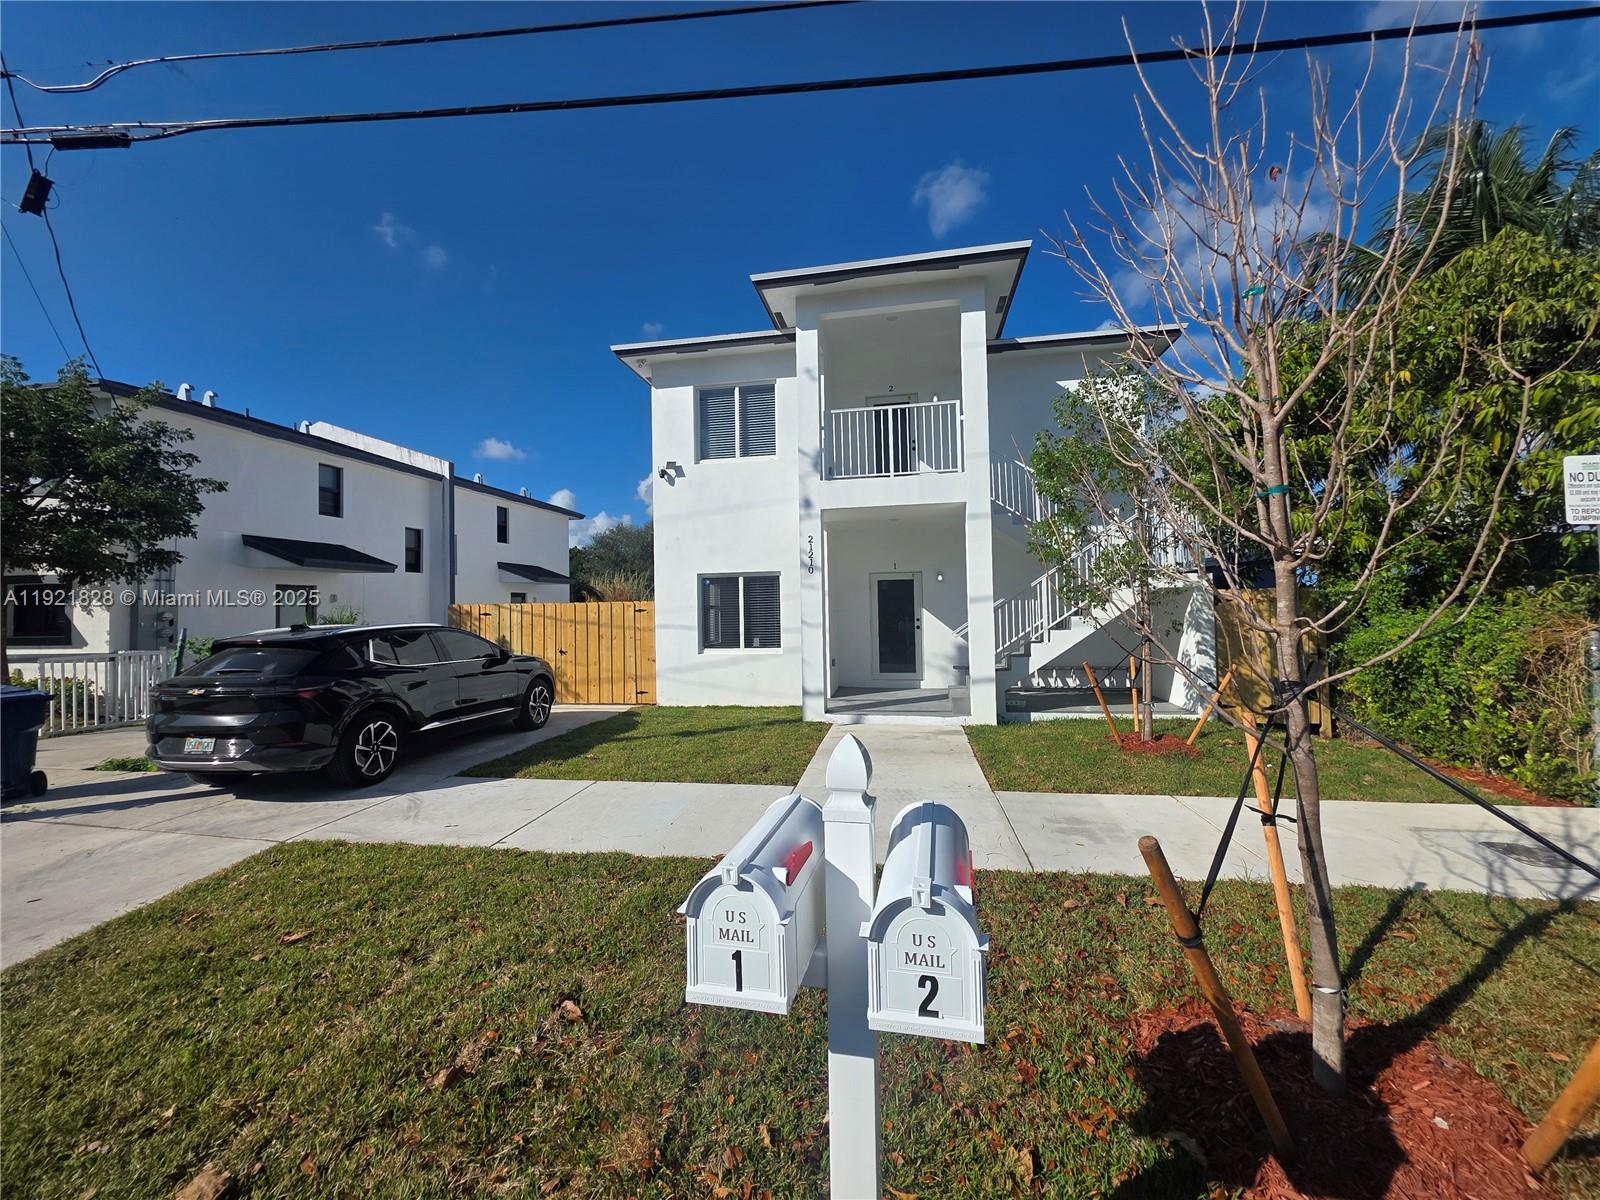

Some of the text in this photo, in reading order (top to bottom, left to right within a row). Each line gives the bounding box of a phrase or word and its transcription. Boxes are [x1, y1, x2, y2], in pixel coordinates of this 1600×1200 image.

[888, 384, 894, 392] 2
[1569, 472, 1585, 482] NO
[719, 927, 754, 943] MAIL
[904, 951, 945, 969] MAIL
[731, 949, 743, 992] 1
[917, 974, 939, 1018] 2
